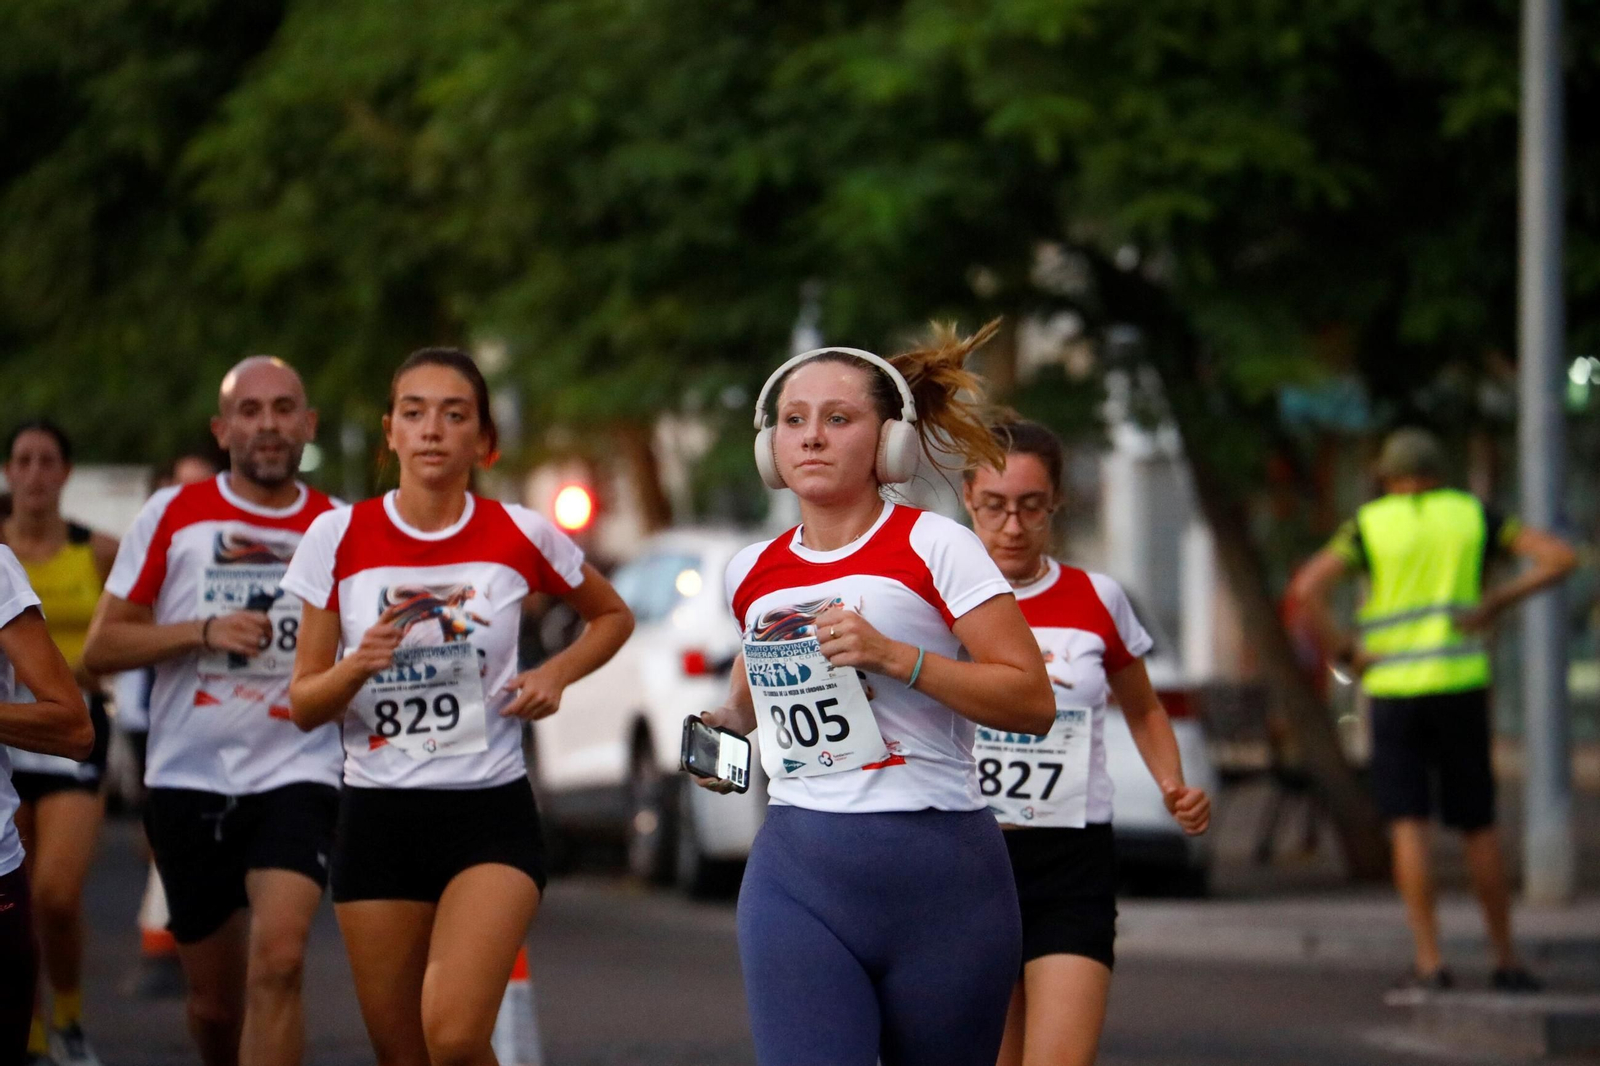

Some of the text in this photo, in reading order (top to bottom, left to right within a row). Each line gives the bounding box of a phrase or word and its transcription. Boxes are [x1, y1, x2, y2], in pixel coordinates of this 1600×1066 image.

[770, 640, 820, 651] PROVINCIA
[374, 693, 460, 738] 829
[770, 697, 850, 750] 805
[978, 758, 1063, 801] 827
